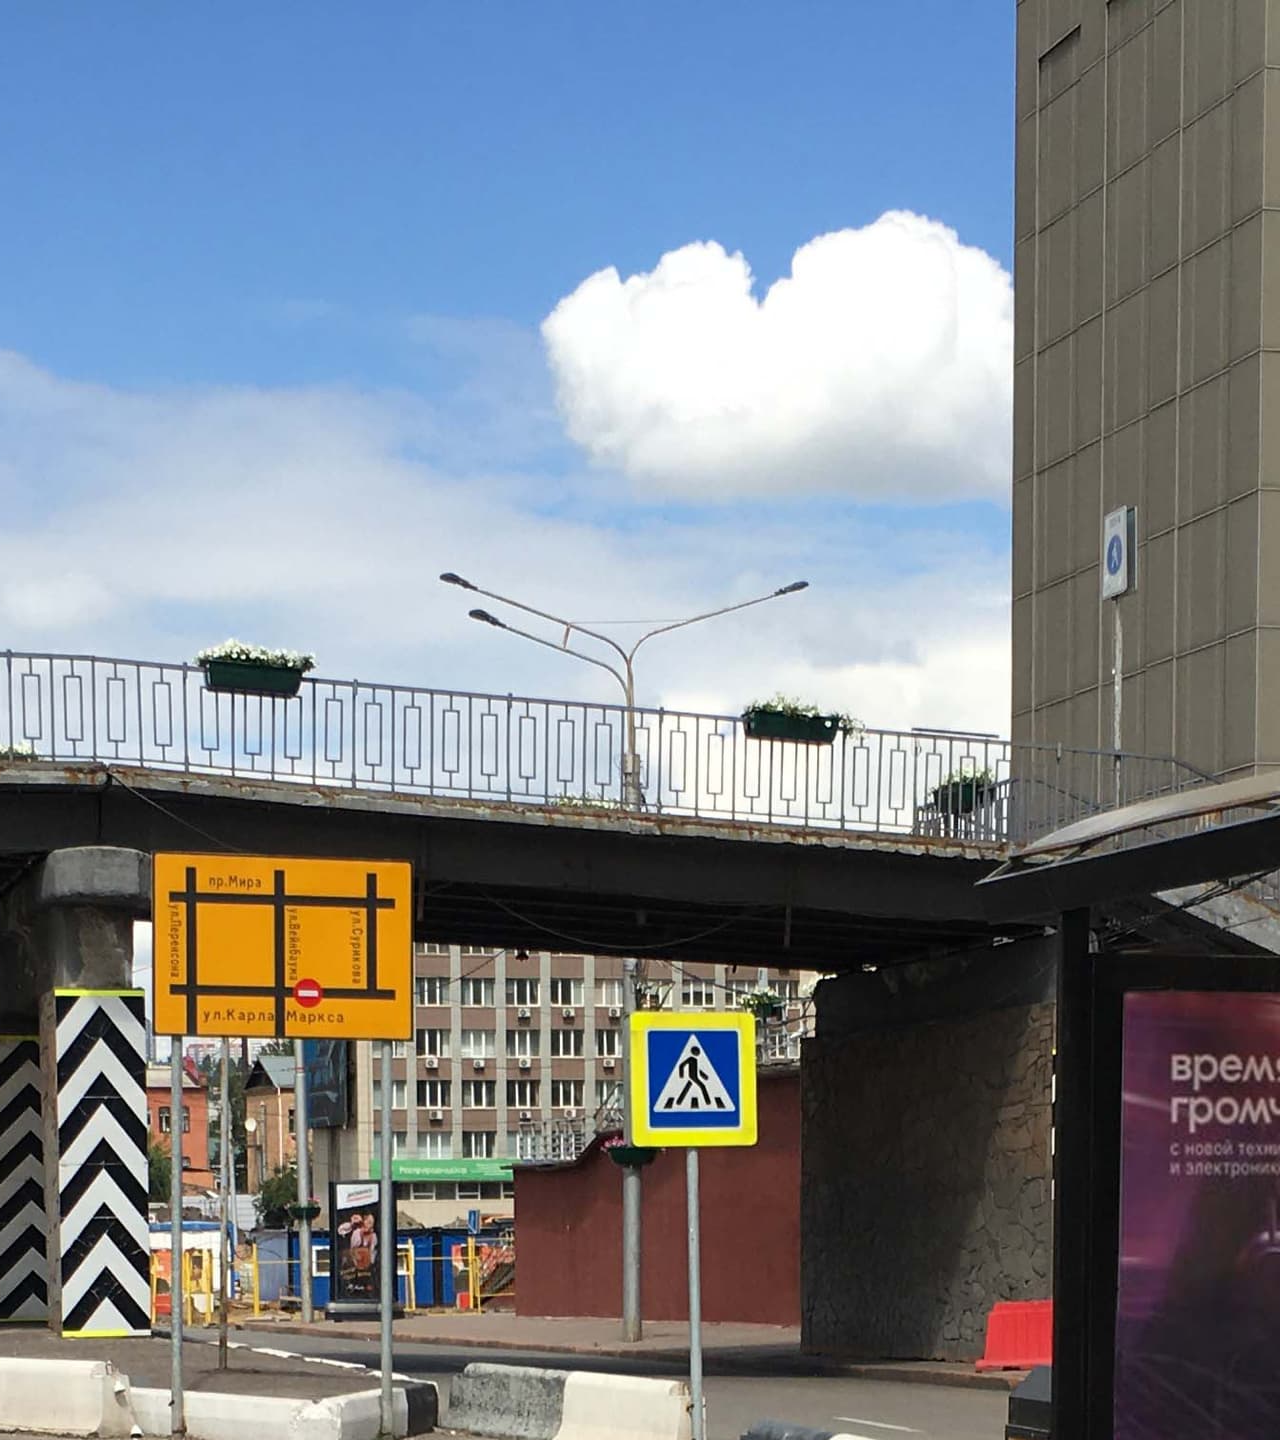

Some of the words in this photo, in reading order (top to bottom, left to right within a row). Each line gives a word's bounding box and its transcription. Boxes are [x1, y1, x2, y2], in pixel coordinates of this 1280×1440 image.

[209, 875, 262, 891] пр.Мира
[350, 910, 364, 984] ул.Сурикова
[203, 1009, 274, 1023] ул.Карла
[287, 1010, 344, 1024] Маркса
[1170, 1142, 1180, 1156] с
[1185, 1140, 1233, 1156] новой
[1169, 1161, 1180, 1176] и
